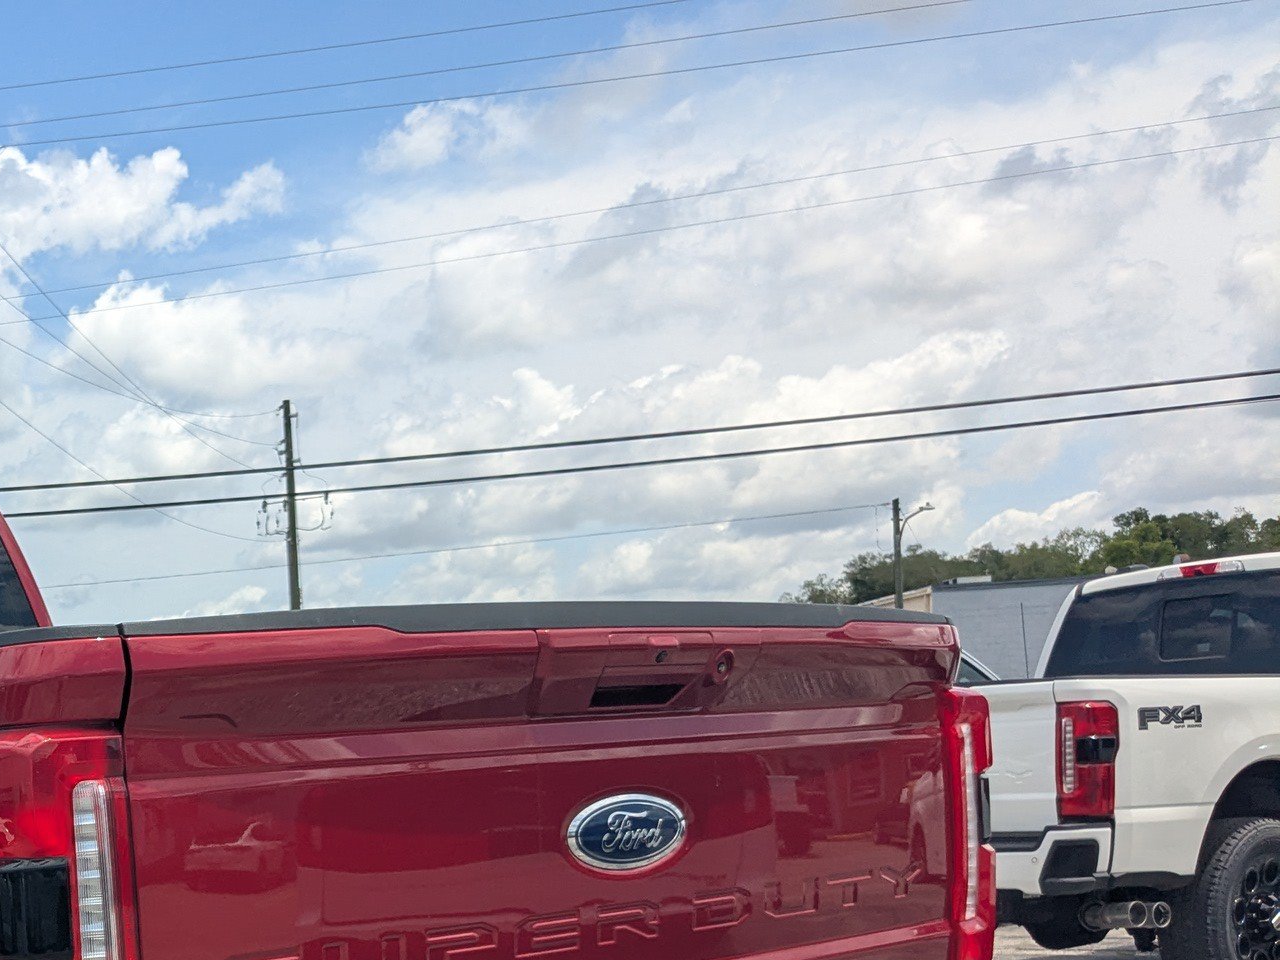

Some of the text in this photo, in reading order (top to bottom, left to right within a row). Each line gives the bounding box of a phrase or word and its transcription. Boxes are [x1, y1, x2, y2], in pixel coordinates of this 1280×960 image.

[1137, 704, 1202, 730] FX4
[601, 810, 663, 853] Ford
[692, 861, 921, 932] DUTY
